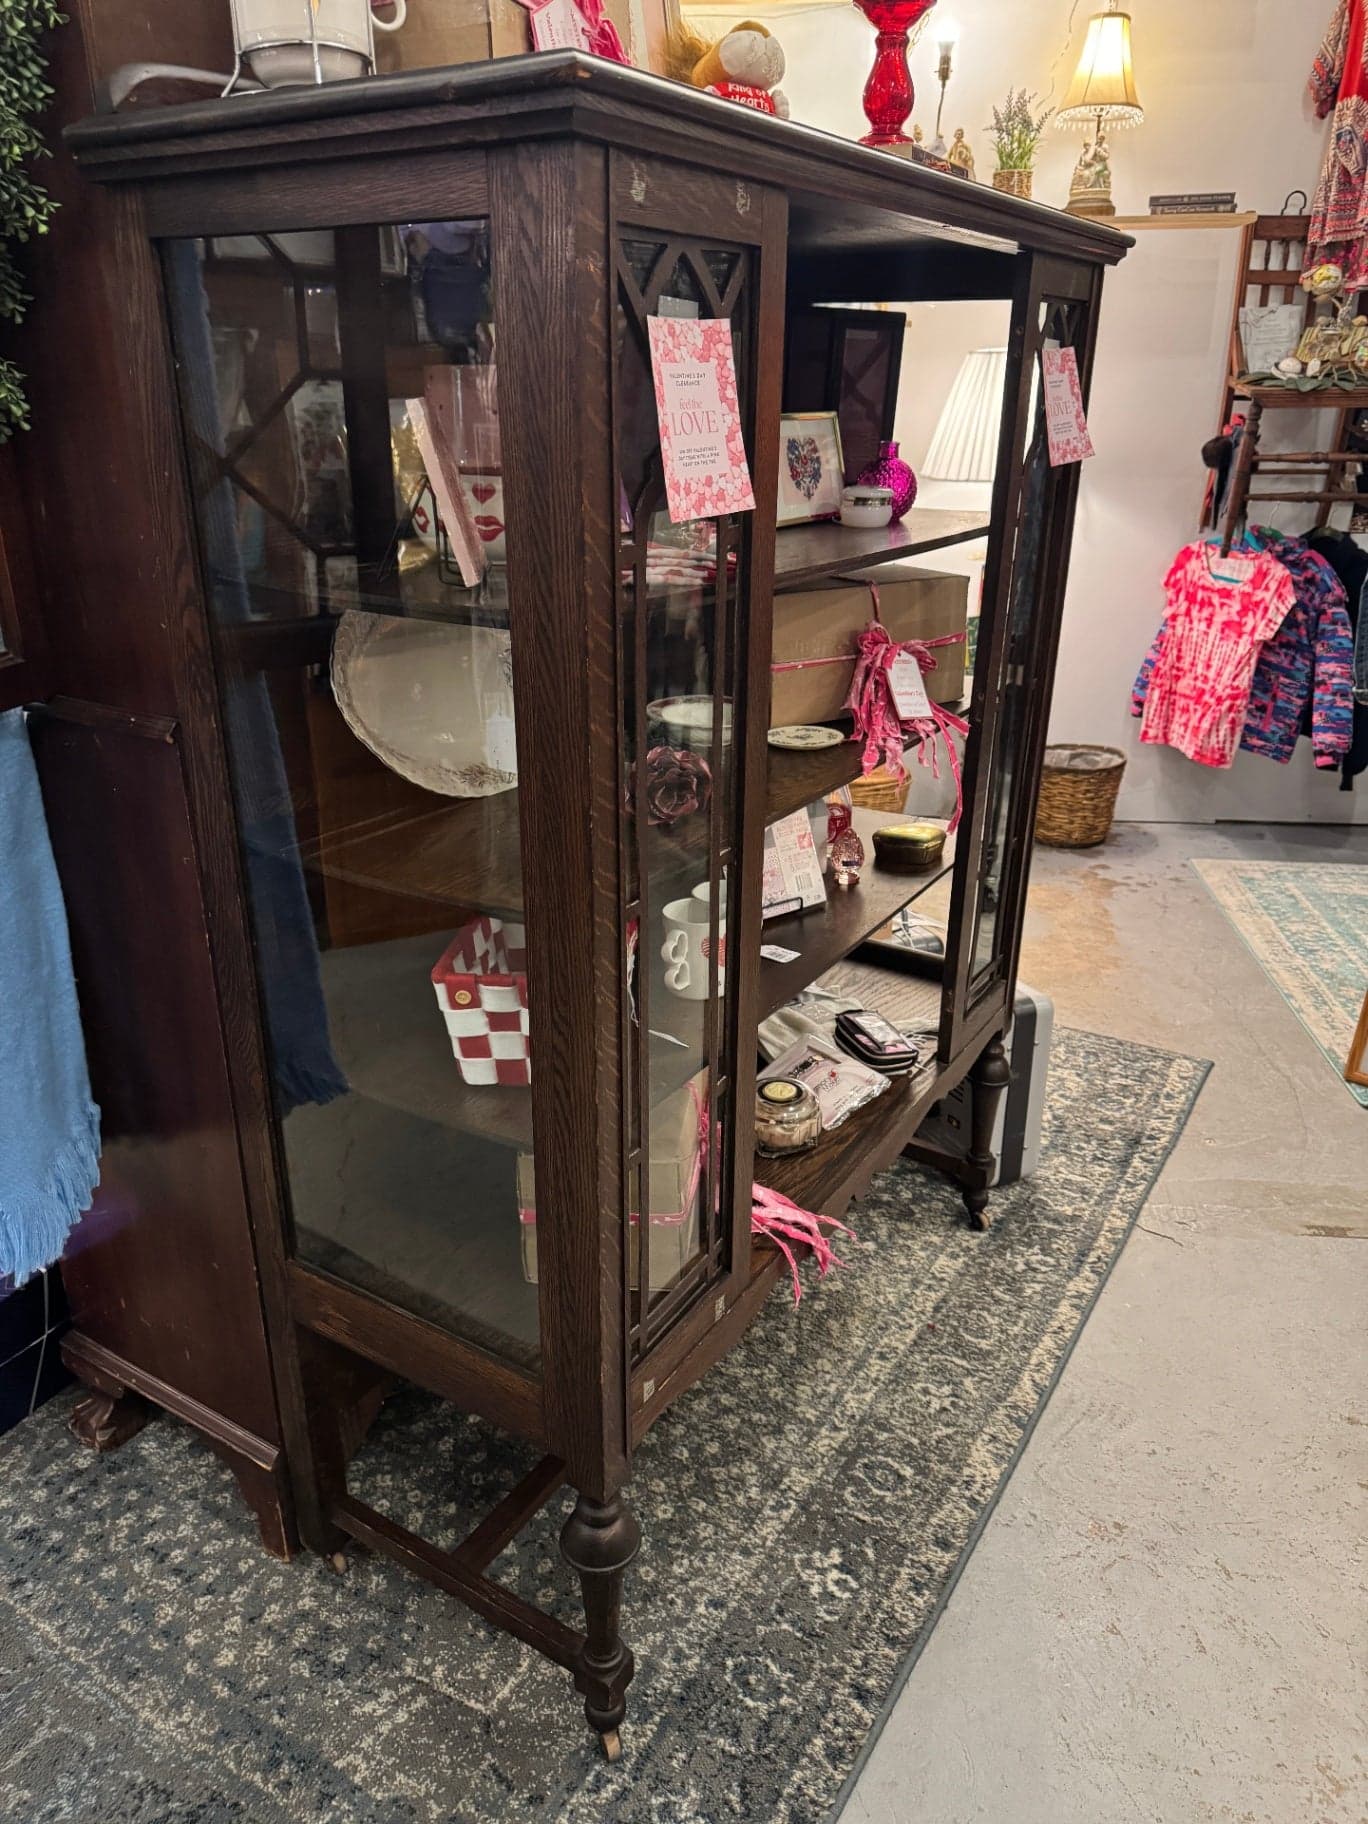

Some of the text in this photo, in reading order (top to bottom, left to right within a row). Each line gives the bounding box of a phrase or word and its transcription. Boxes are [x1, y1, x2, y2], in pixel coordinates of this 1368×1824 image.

[728, 83, 754, 97] King
[1050, 401, 1073, 416] LOVE
[671, 410, 719, 436] LOVE
